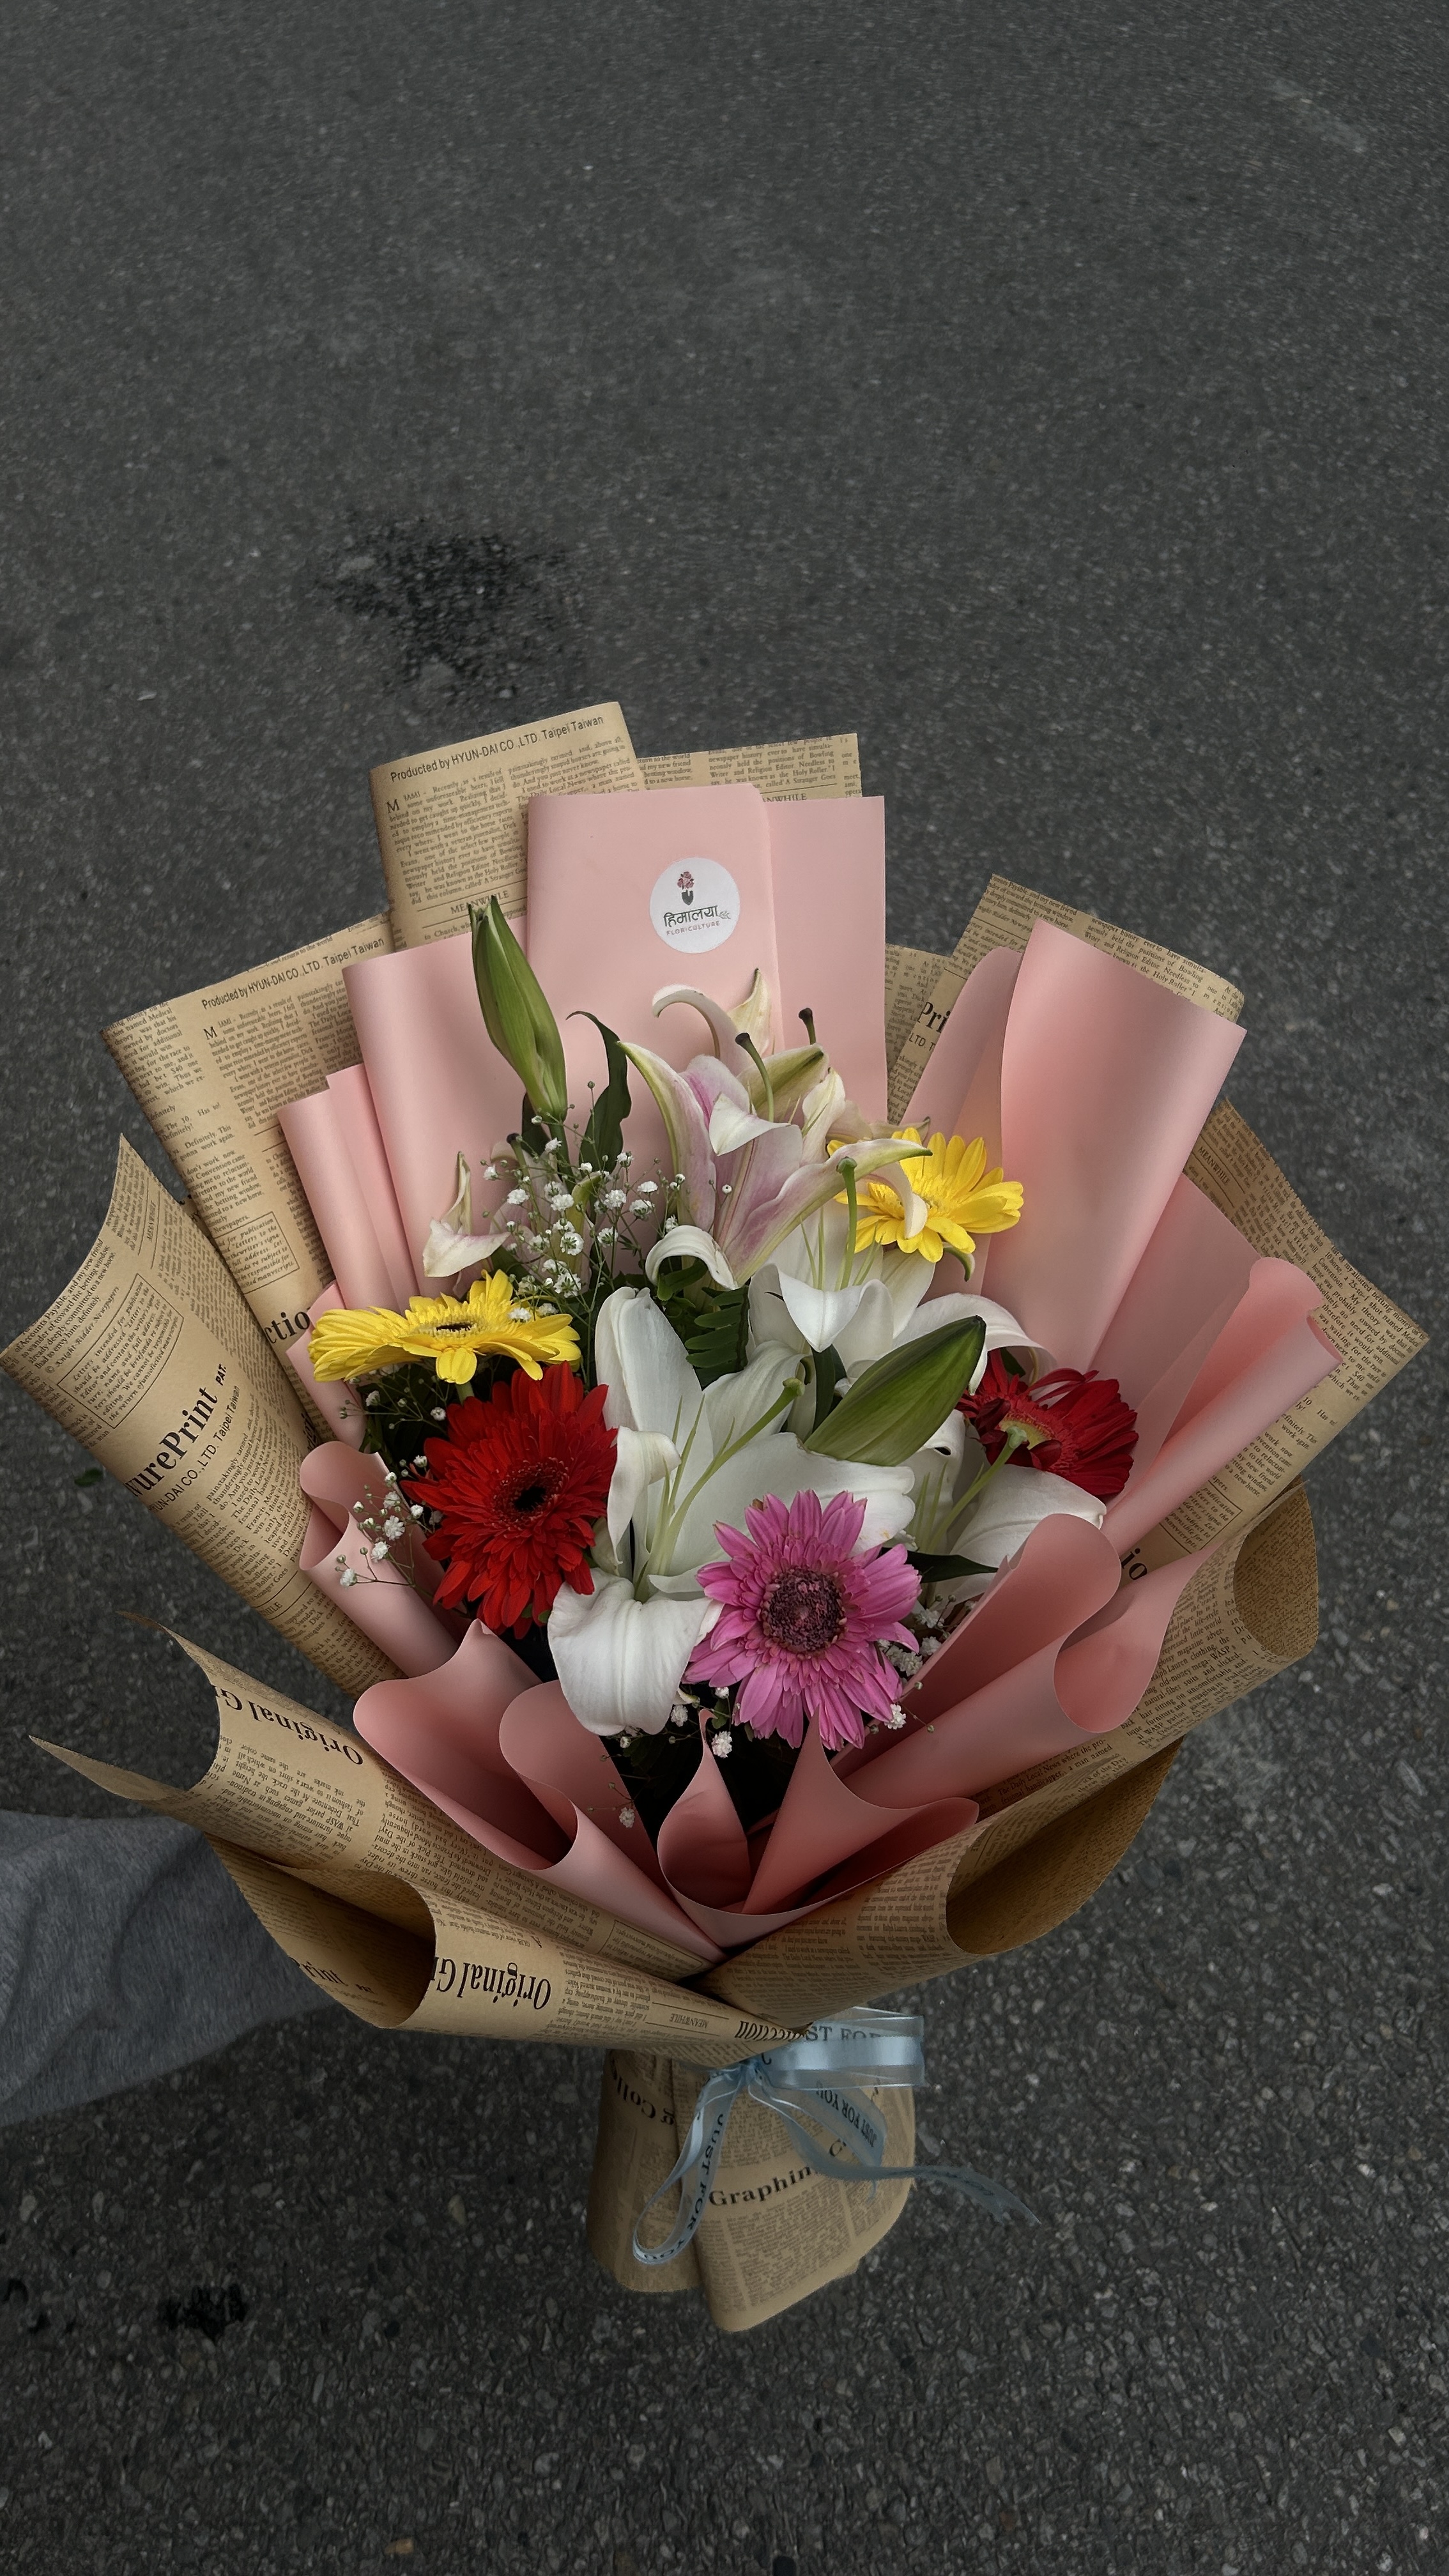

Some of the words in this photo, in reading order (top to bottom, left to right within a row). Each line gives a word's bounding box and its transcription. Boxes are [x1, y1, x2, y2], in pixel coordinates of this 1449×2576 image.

[389, 761, 437, 784] Producted
[438, 759, 449, 769] by
[451, 744, 498, 765] HYUN-DAI
[541, 724, 570, 739] Taipei
[571, 717, 603, 731] Taiwan
[387, 799, 399, 814] M
[666, 921, 719, 935] FLORICULTURE
[202, 989, 239, 1009] Producted
[238, 988, 248, 997] by
[248, 972, 286, 993] HYUN-DAI
[323, 951, 351, 965] Taipei
[351, 938, 385, 954] Taiwan
[204, 1027, 217, 1039] M
[1199, 1146, 1230, 1186] MEANWHILE
[19, 1321, 47, 1347] Accounts
[68, 1280, 79, 1294] and
[77, 1271, 86, 1281] my
[84, 1259, 93, 1270] new
[91, 1238, 103, 1257] friend
[27, 1331, 49, 1352] wander
[72, 1291, 82, 1301] the
[79, 1269, 98, 1290] betting
[78, 1297, 99, 1323] definitely
[1350, 1294, 1360, 1305] My
[1369, 1302, 1383, 1315] shot
[47, 1327, 66, 1345] deeply
[65, 1290, 92, 1325] committed
[72, 1360, 93, 1381] Letters
[95, 1327, 118, 1356] intended
[73, 1374, 91, 1394] should
[102, 1331, 126, 1363] addressed
[104, 1370, 119, 1387] name
[122, 1352, 132, 1367] and
[132, 1337, 142, 1352] full
[111, 1343, 129, 1367] contain
[107, 1377, 125, 1399] should
[122, 1381, 133, 1390] We
[134, 1358, 150, 1381] cannot
[109, 1411, 119, 1421] the
[118, 1390, 137, 1411] return
[213, 1413, 233, 1441] Taipei
[249, 1701, 364, 1765] Original
[457, 1963, 551, 2010] Original
[709, 2166, 811, 2205] Graphin
